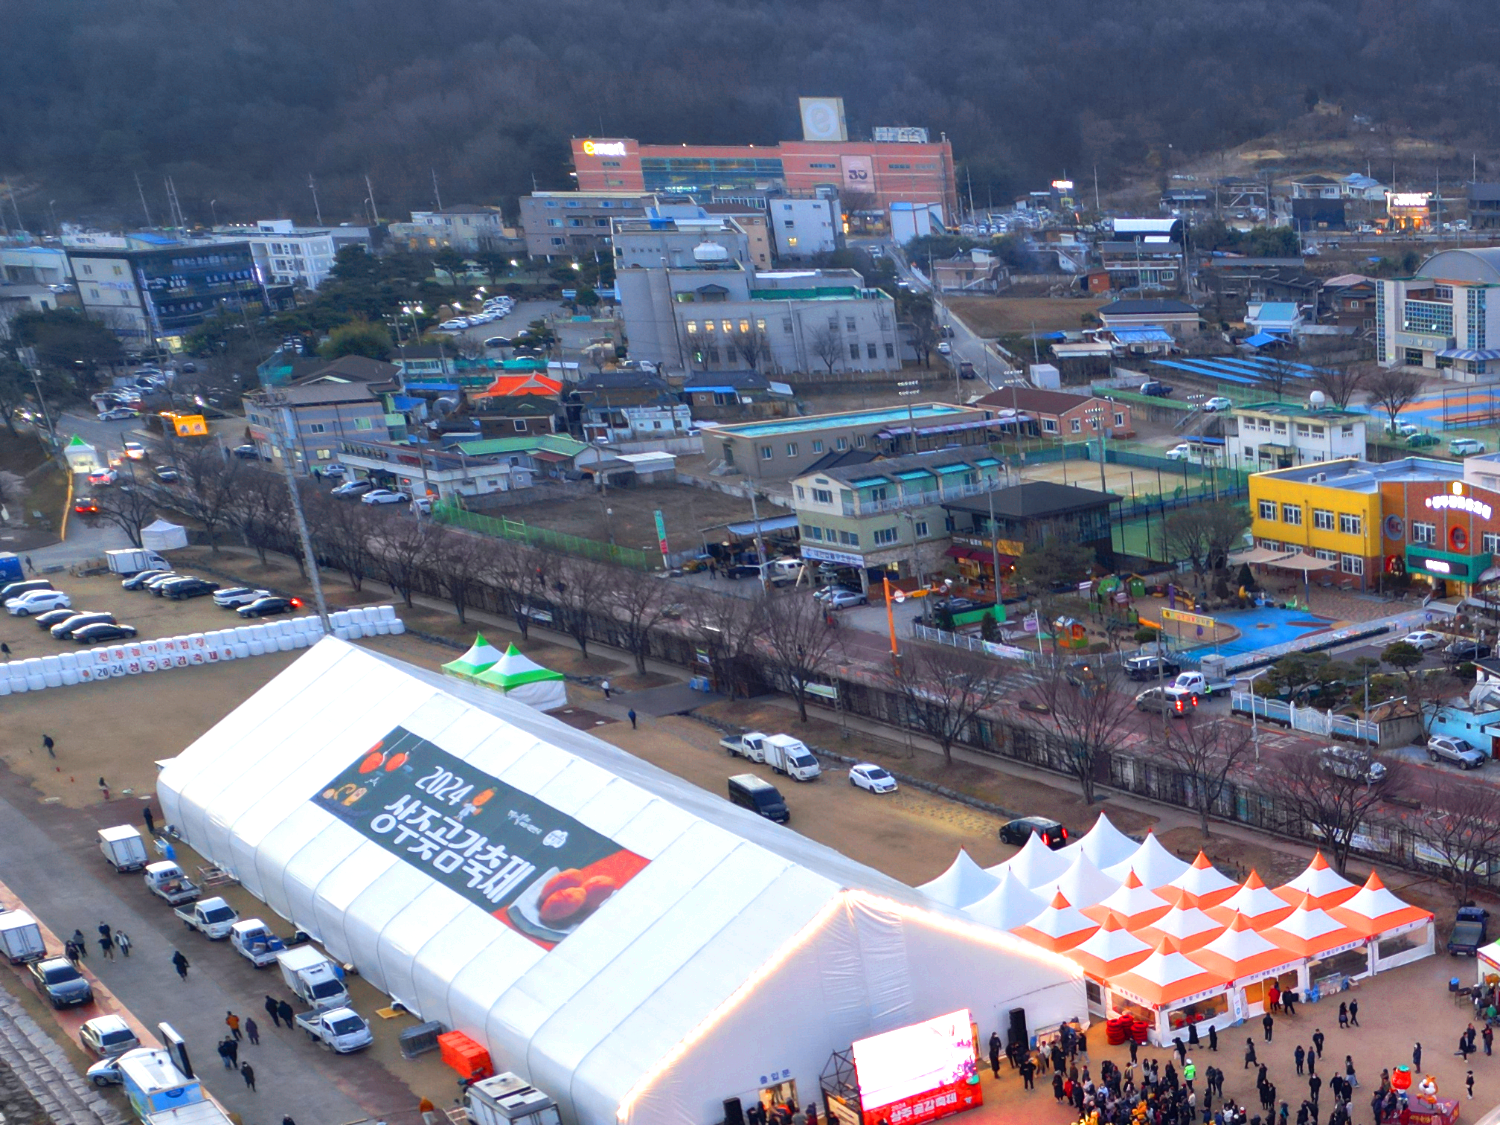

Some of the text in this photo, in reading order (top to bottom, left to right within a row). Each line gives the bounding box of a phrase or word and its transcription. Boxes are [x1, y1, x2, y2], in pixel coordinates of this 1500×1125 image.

[97, 664, 125, 678] 2024
[414, 765, 475, 806] 2024
[370, 794, 537, 904] 상주곶감축제
[760, 1068, 791, 1085] 출입문
[890, 1091, 958, 1123] 상주 곶감 축제
